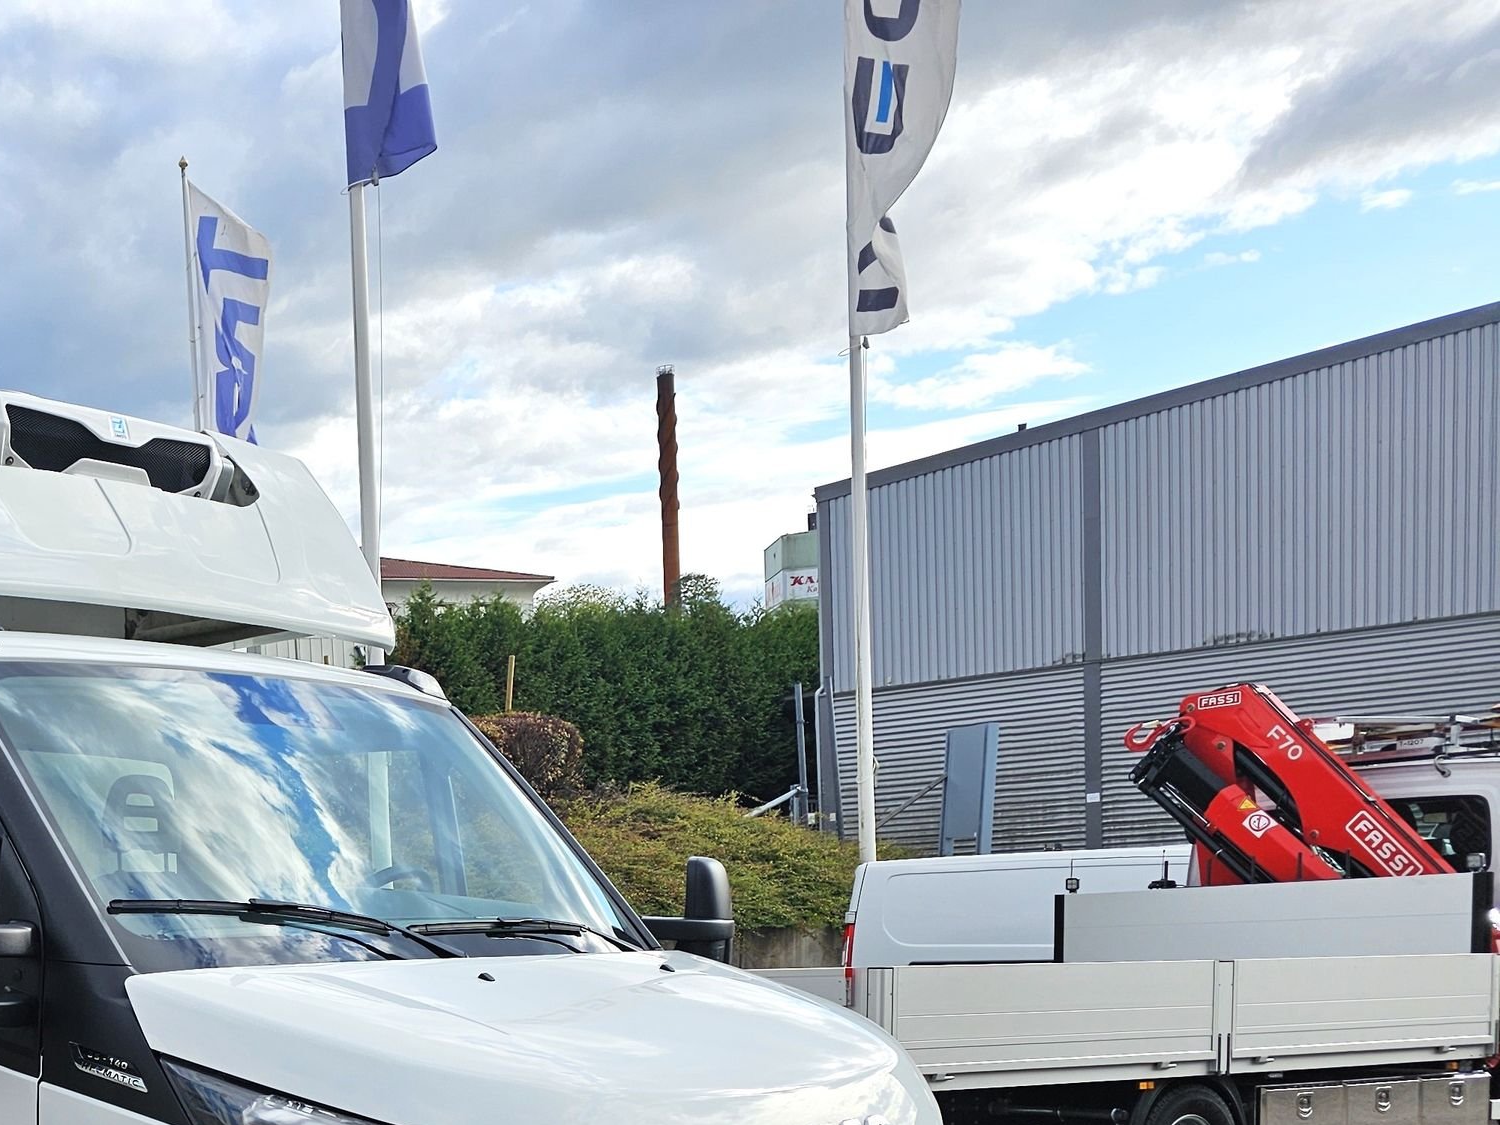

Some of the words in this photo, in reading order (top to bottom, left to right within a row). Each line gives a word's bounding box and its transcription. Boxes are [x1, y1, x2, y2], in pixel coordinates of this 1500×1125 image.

[1201, 694, 1238, 707] FASSI
[1266, 724, 1303, 760] F70
[1354, 819, 1414, 876] FASSI
